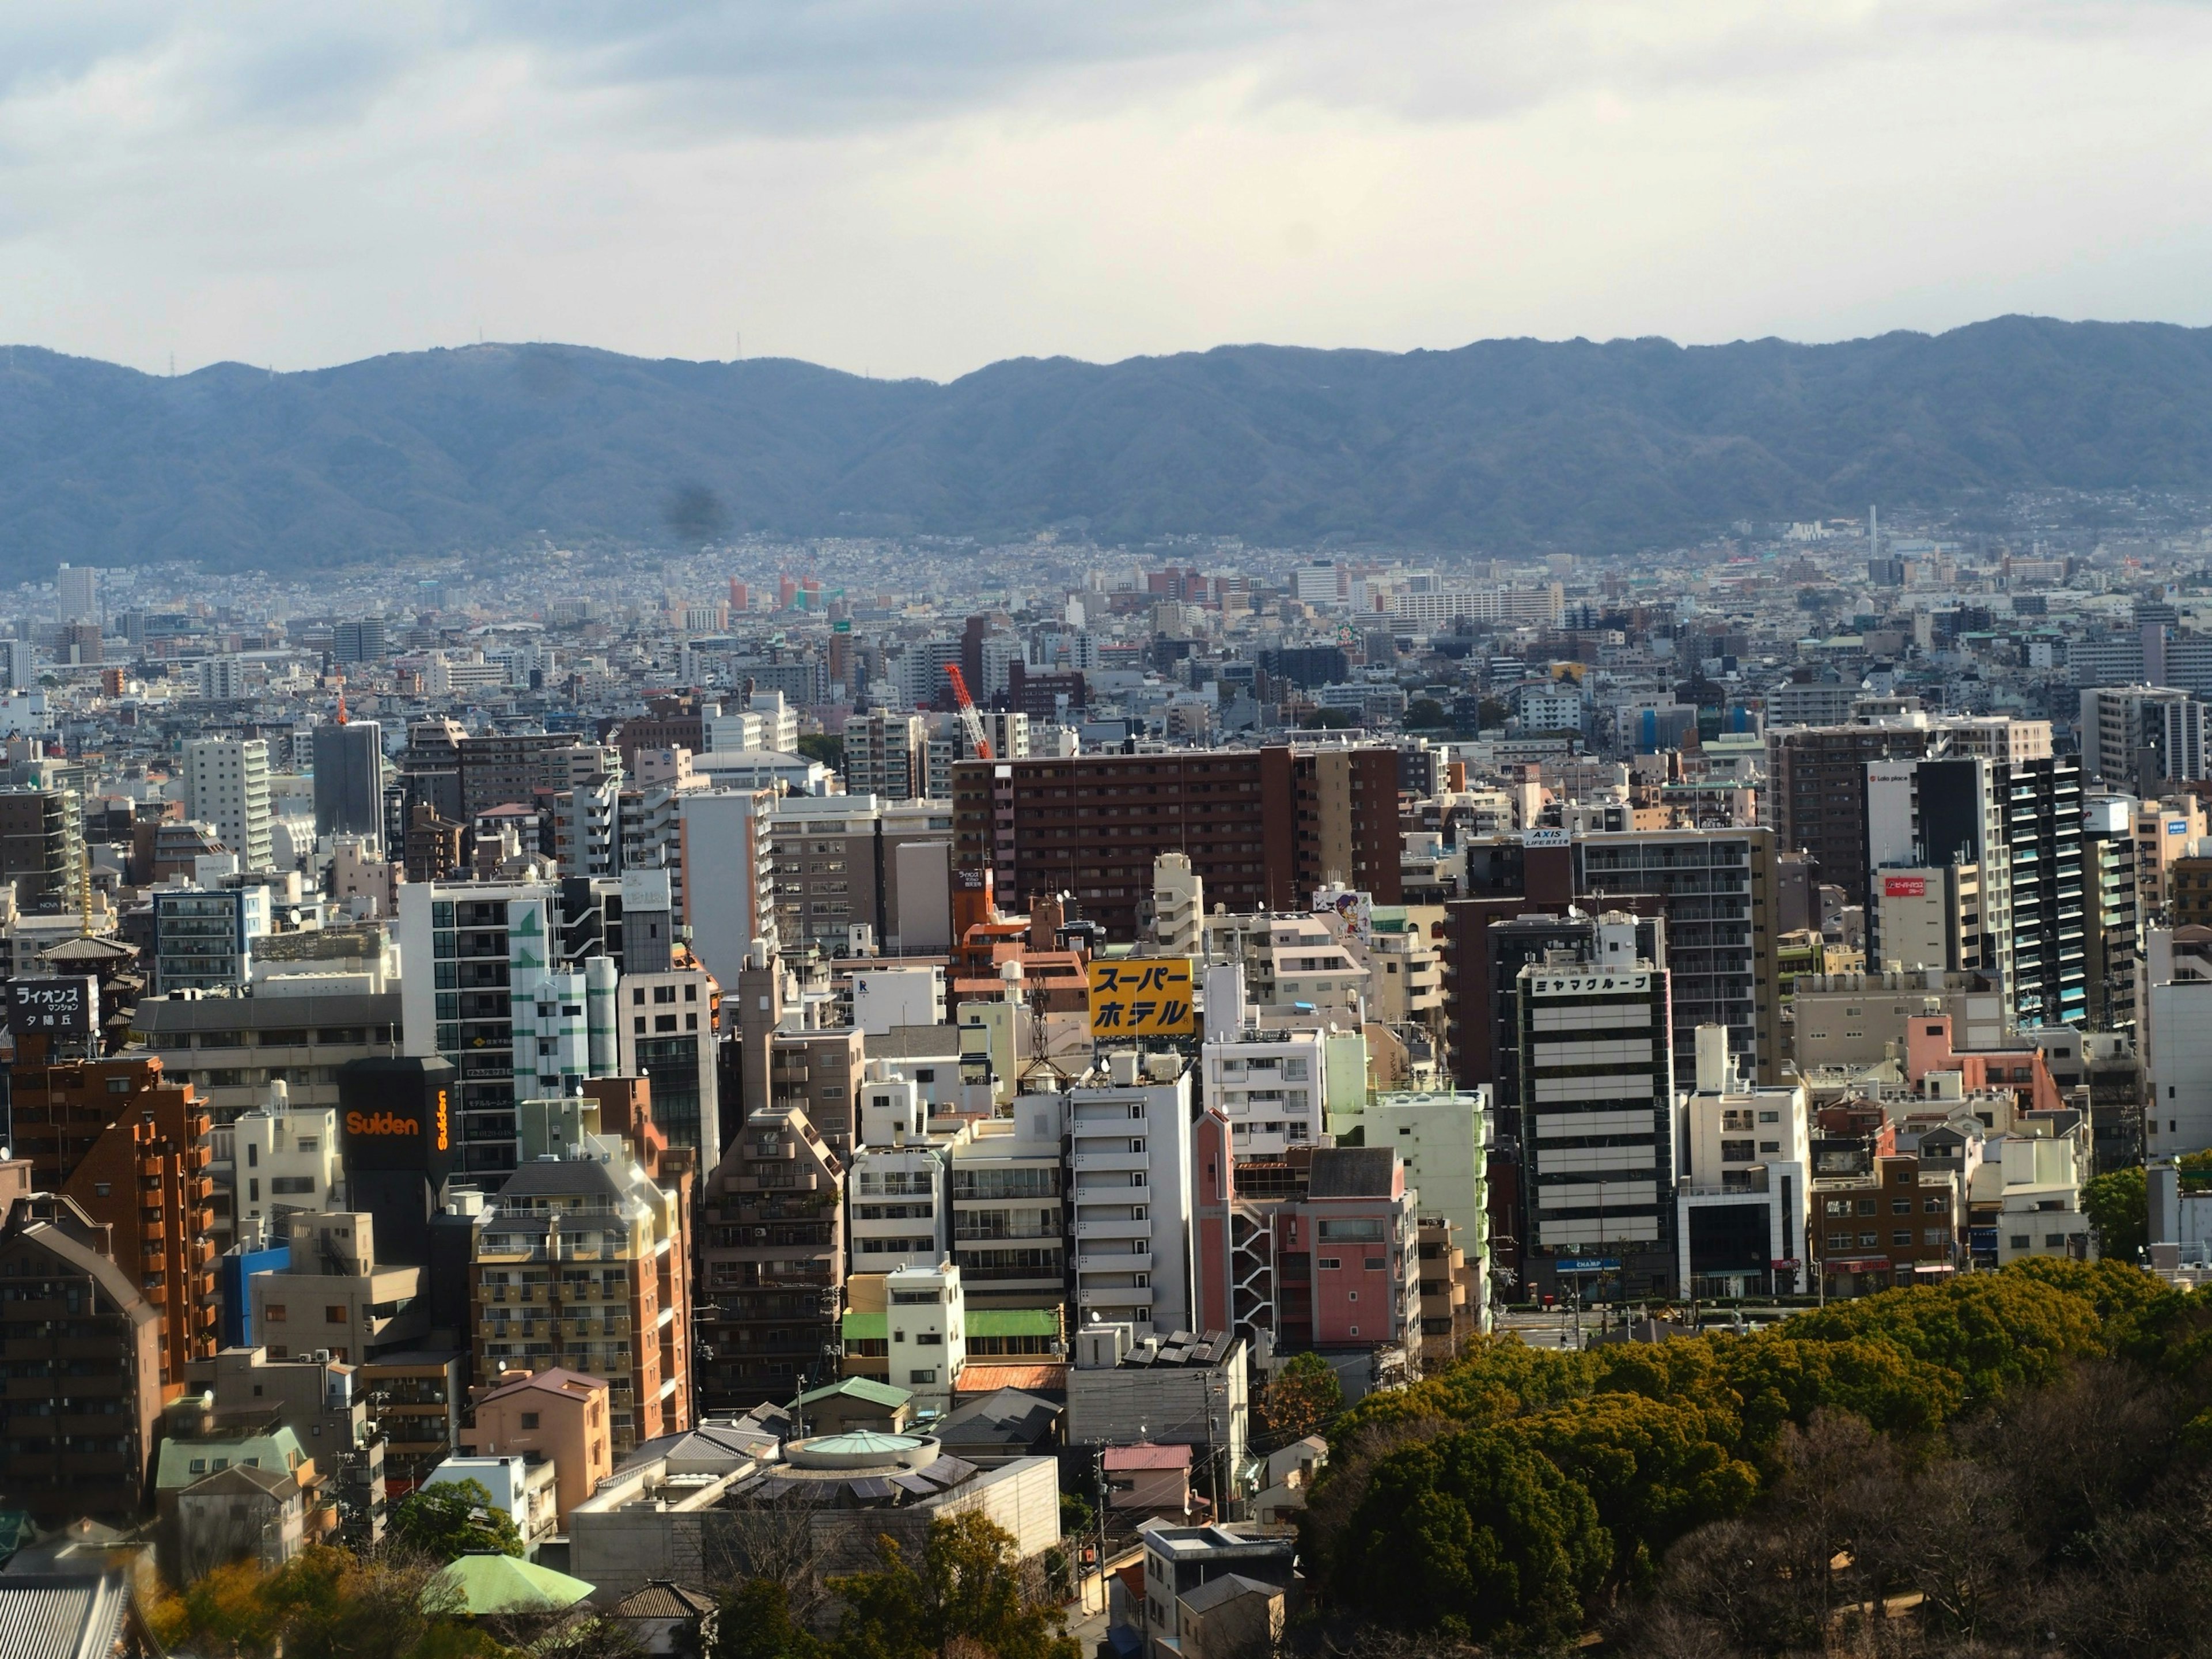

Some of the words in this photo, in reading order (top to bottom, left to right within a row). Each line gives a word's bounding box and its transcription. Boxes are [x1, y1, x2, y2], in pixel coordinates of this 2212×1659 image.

[1093, 967, 1188, 993] スーパー
[1535, 976, 1646, 992] ミヤマグループ
[16, 987, 78, 1004] ライオンズ
[26, 1014, 72, 1027] 夕陽丘
[347, 1111, 419, 1135] Suiden
[436, 1090, 448, 1151] Suiden
